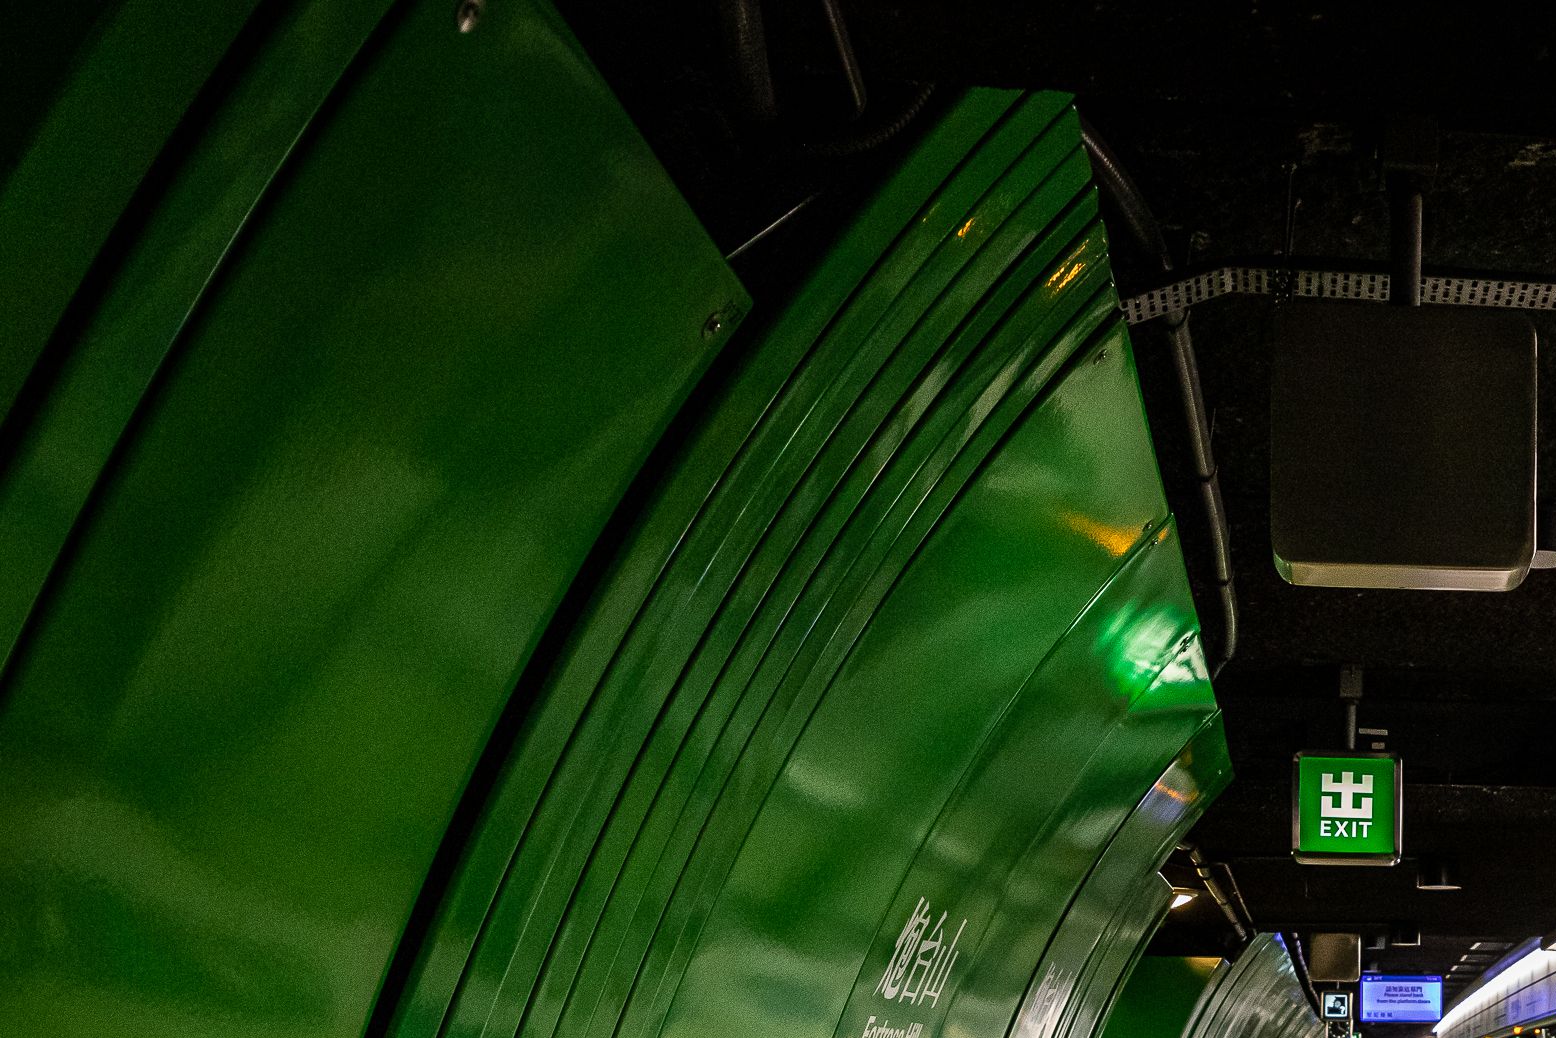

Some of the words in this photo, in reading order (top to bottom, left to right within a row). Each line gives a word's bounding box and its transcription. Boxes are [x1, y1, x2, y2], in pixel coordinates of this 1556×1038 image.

[1320, 820, 1373, 838] EXIT
[872, 896, 967, 1008] 炮台山
